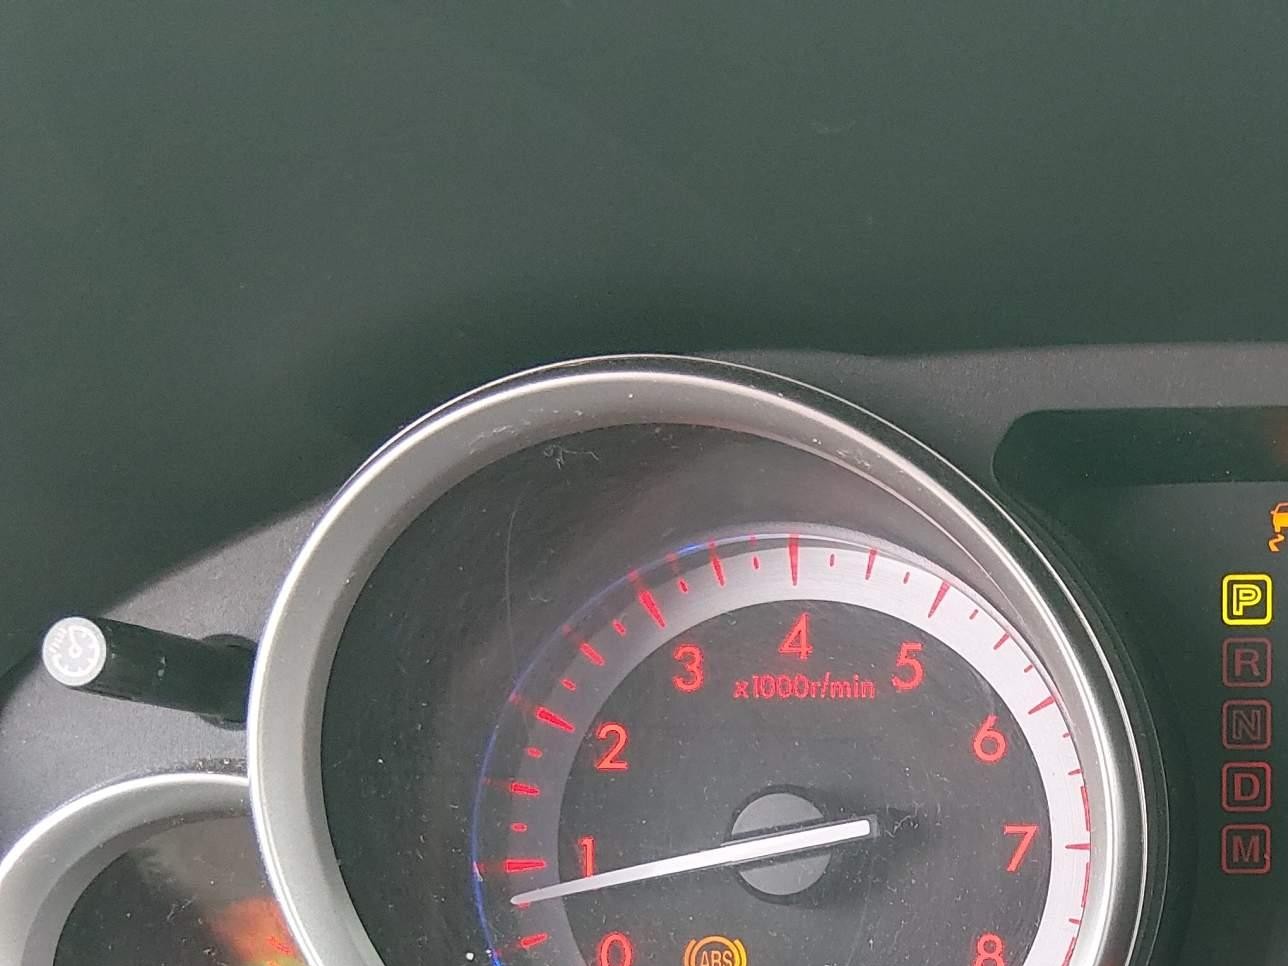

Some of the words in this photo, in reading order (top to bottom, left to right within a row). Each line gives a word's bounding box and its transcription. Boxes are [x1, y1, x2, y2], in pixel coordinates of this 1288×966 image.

[1232, 583, 1262, 616] P
[779, 614, 813, 659] 4
[673, 645, 705, 692] 3
[891, 643, 923, 690] 5
[1233, 648, 1261, 678] R
[733, 672, 876, 699] x1000r/min
[972, 716, 1006, 762] 6
[1232, 709, 1262, 741] N
[596, 723, 629, 771] 2
[1233, 772, 1261, 801] D
[579, 836, 596, 879] 1
[1002, 825, 1038, 872] 7
[1232, 835, 1261, 865] M
